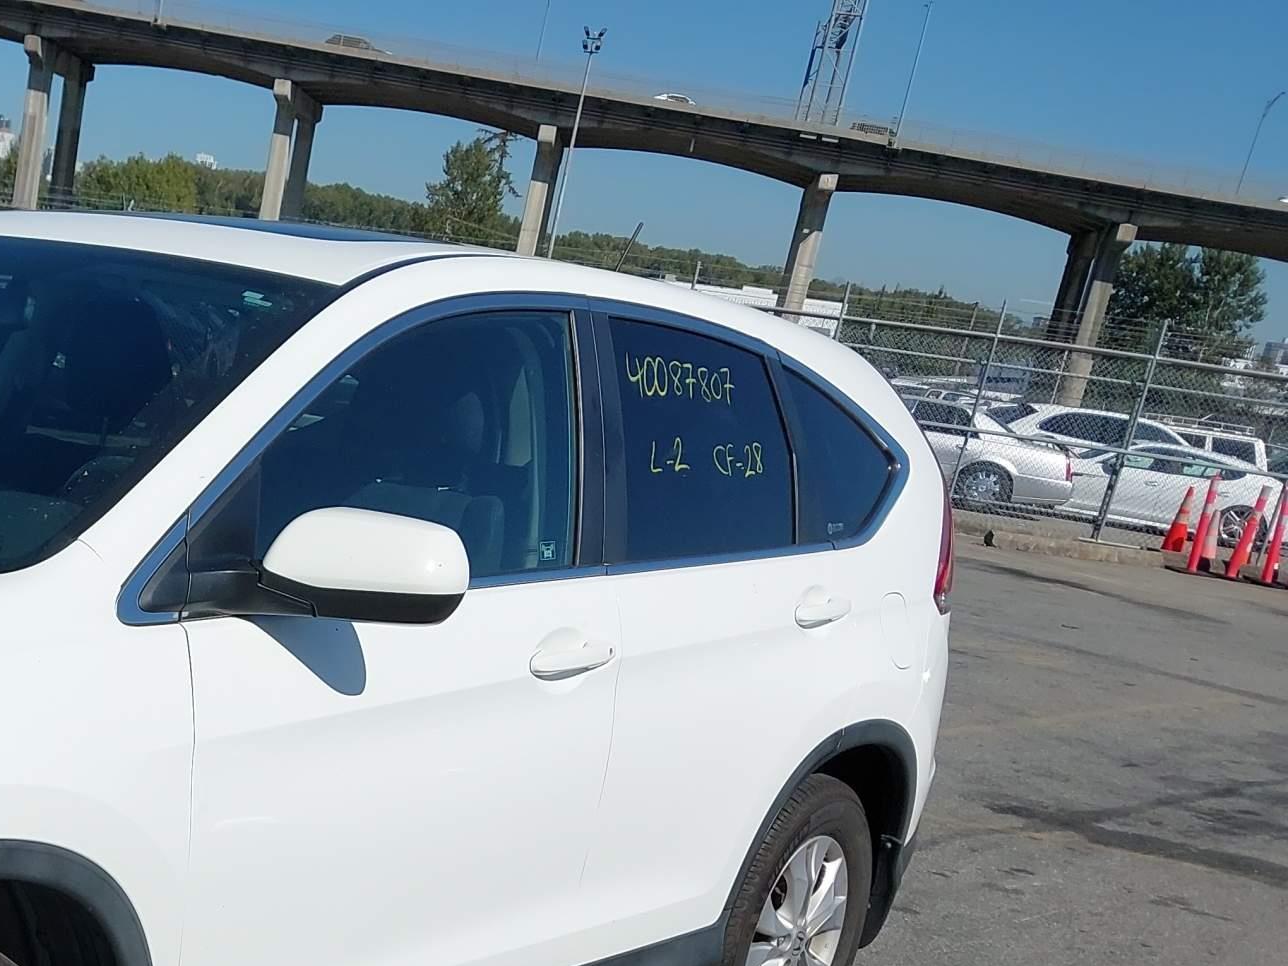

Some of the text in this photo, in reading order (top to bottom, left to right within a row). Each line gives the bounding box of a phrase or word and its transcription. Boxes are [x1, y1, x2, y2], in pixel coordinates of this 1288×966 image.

[625, 352, 735, 405] 40087807
[650, 437, 763, 477] L-2 CF-28
